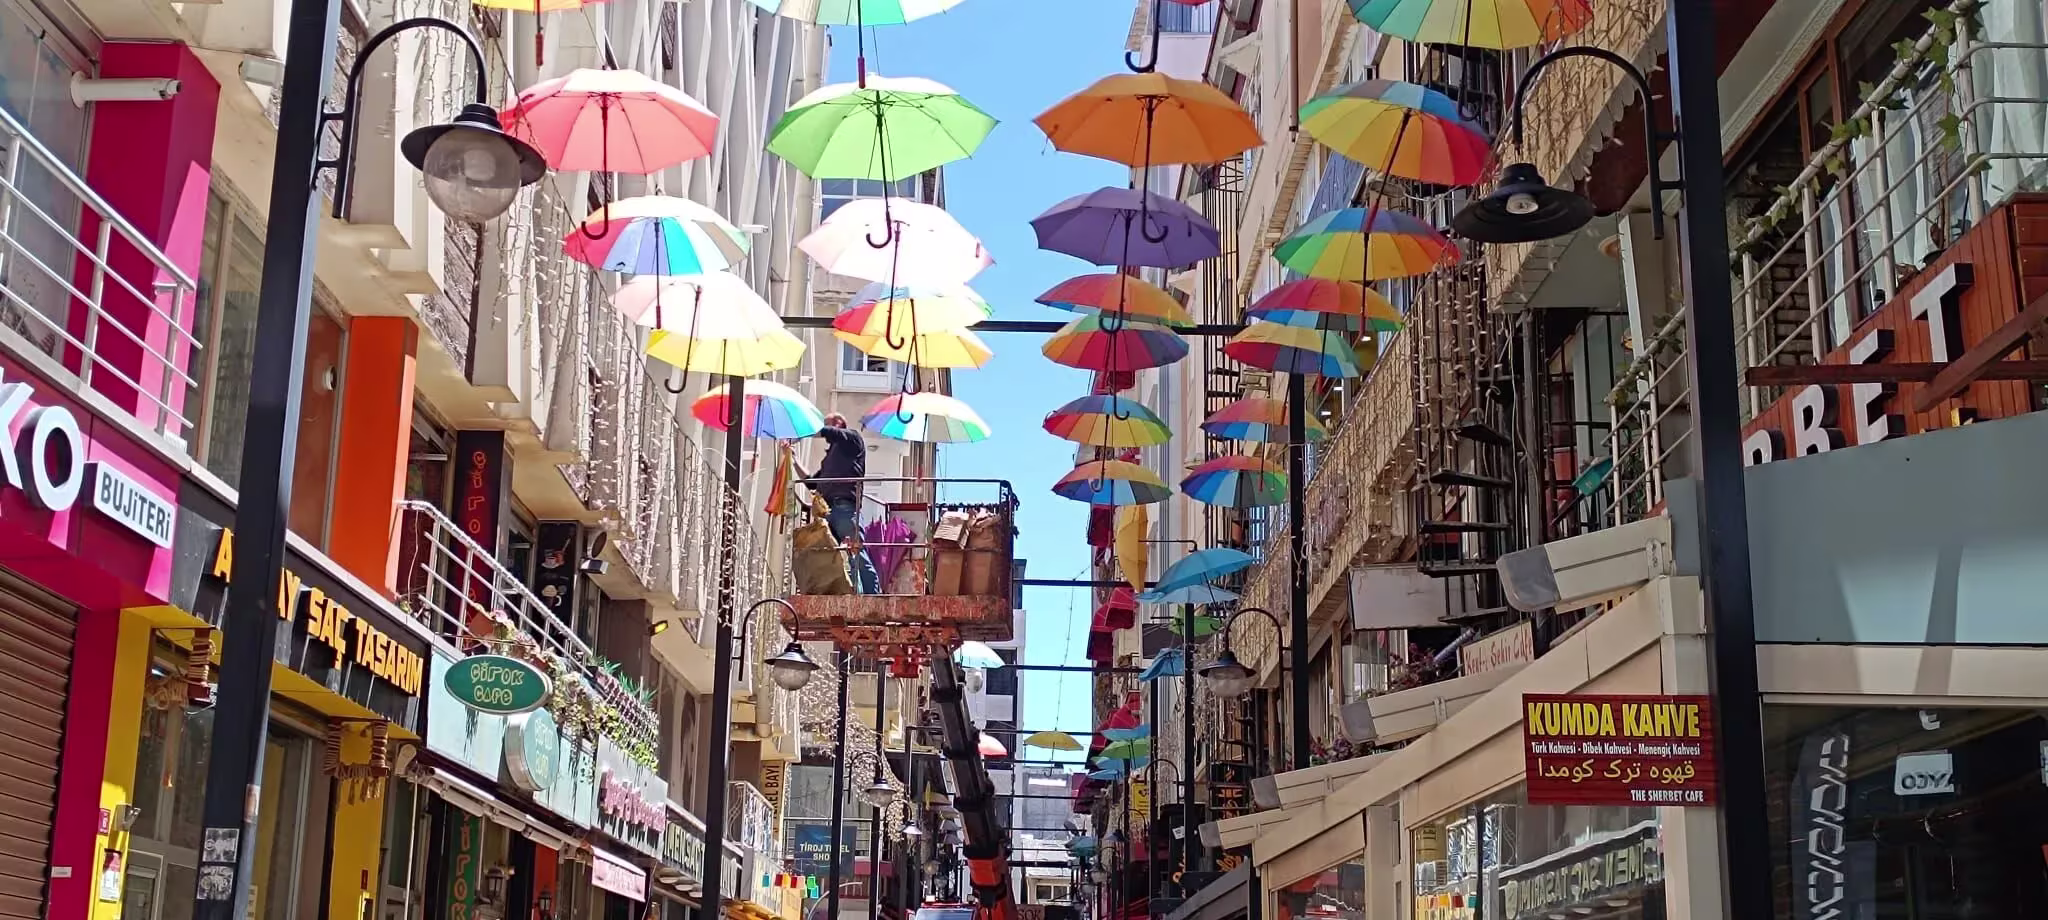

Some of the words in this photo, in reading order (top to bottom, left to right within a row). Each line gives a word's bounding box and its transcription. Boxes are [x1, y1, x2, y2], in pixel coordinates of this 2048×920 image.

[307, 586, 351, 671] SAÇ
[355, 616, 424, 698] TASARIM
[1527, 702, 1617, 736] KUMDA
[1621, 703, 1700, 737] KAHVE
[1531, 741, 1547, 754] Türk
[1548, 741, 1577, 754] Kahvesi
[1582, 741, 1603, 754] Dibek
[1604, 742, 1632, 755] Kahvesi
[1638, 742, 1672, 758] Menengiç
[1672, 742, 1701, 755] Kahvesi
[1649, 760, 1695, 784] قهوه
[1631, 789, 1647, 801] THE
[1648, 789, 1683, 802] SHERBET
[1684, 790, 1704, 802] CAFE
